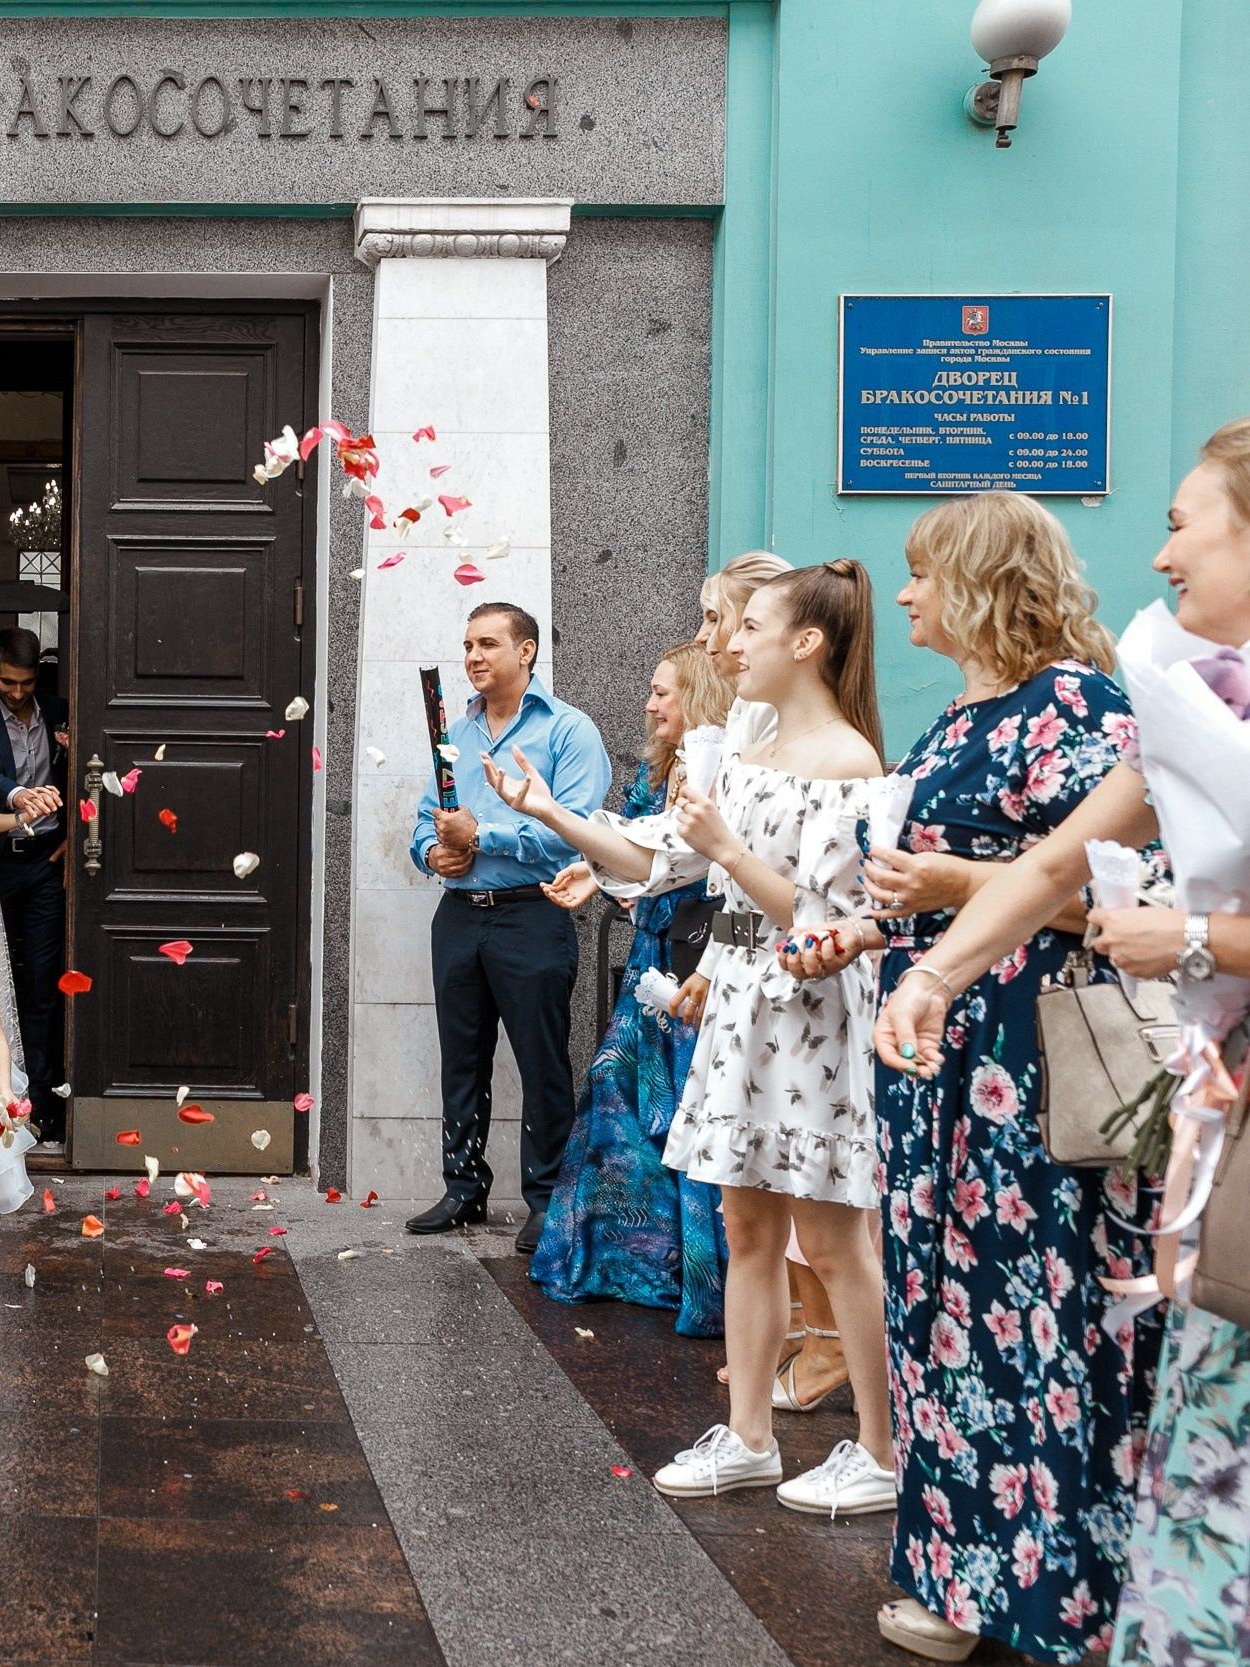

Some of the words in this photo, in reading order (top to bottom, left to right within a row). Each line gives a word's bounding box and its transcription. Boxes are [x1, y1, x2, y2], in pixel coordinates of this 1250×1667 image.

[922, 339, 991, 347] Правительство
[992, 339, 1029, 347] Москвы
[860, 347, 914, 356] Управление
[977, 348, 1043, 356] гражданского
[974, 355, 1011, 363] Москвы
[931, 371, 1019, 388] ДВОРЕЦ
[860, 390, 1053, 405] БРАКОСОЧЕТАНИЯ
[934, 413, 968, 422] ЧАСЫ
[969, 413, 1016, 422] РАБОТЫ
[860, 426, 936, 435] ПОНЕДЕЛЬНИК,
[938, 426, 987, 435] ВТОРНИК,
[860, 436, 896, 445] СРЕДА,
[898, 436, 943, 445] ЧЕТВЕРГ,
[946, 436, 993, 445] ПЯТНИЦА
[1017, 432, 1045, 440] 09.00
[1045, 433, 1059, 441] до
[1062, 432, 1089, 440] 18.00
[859, 447, 905, 456] СУББОТА
[1016, 449, 1045, 457] 09.00
[1045, 449, 1059, 457] до
[1061, 448, 1088, 457] 24.00
[859, 459, 931, 468] ВОСКРЕСЕНЬЕ
[1016, 460, 1044, 468] 00.00
[1045, 461, 1059, 469] до
[1061, 460, 1088, 468] 18.00
[972, 472, 1011, 480] КАЖДОГО
[1012, 472, 1042, 480] МЕСЯЦА
[930, 480, 991, 488] САНИТАРНЫЙ
[991, 480, 1017, 489] ДЕНЬ
